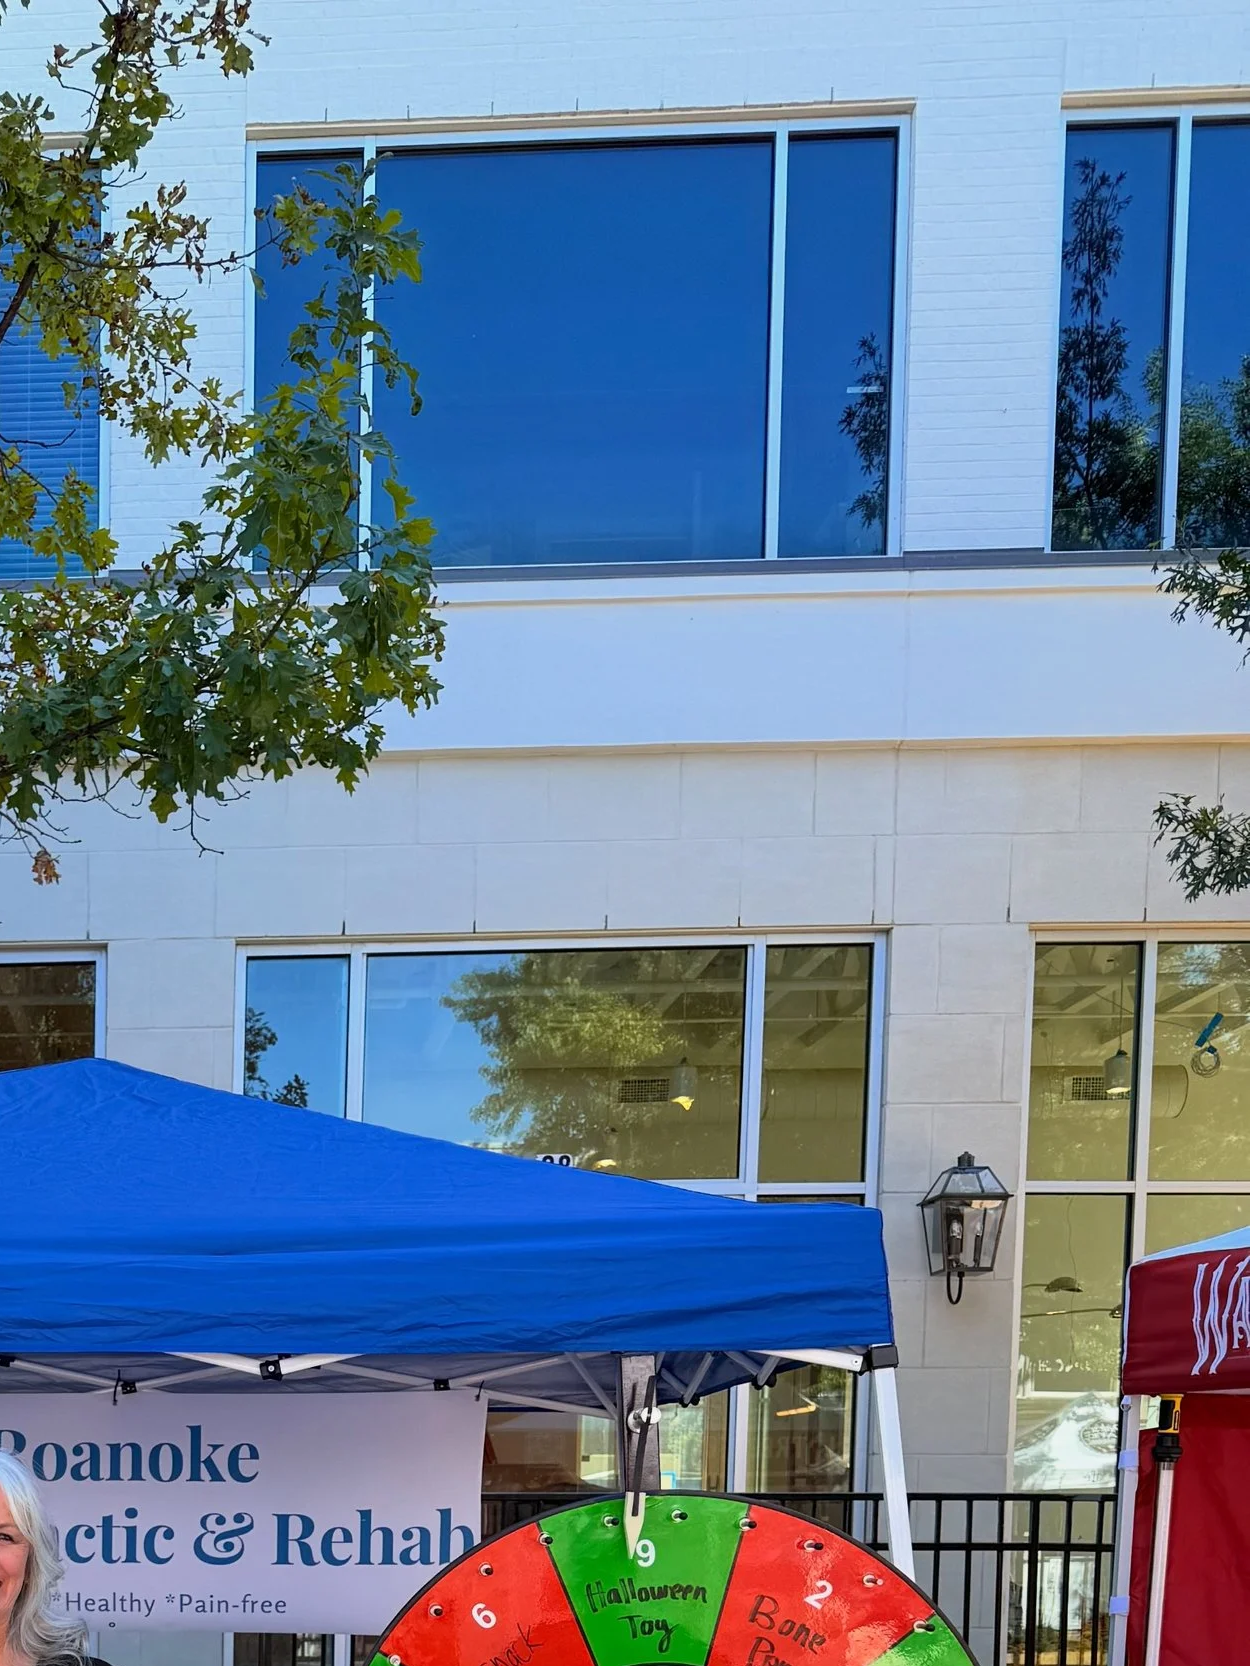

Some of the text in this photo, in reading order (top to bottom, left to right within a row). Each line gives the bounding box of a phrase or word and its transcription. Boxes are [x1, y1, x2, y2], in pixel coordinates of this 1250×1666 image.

[194, 1512, 255, 1566] &
[271, 1508, 476, 1567] Rehab
[635, 1539, 656, 1568] 9
[585, 1578, 707, 1613] Halloween
[804, 1579, 833, 1610] 2
[471, 1602, 497, 1629] 6
[748, 1594, 827, 1655] Bone
[617, 1614, 679, 1653] Toy
